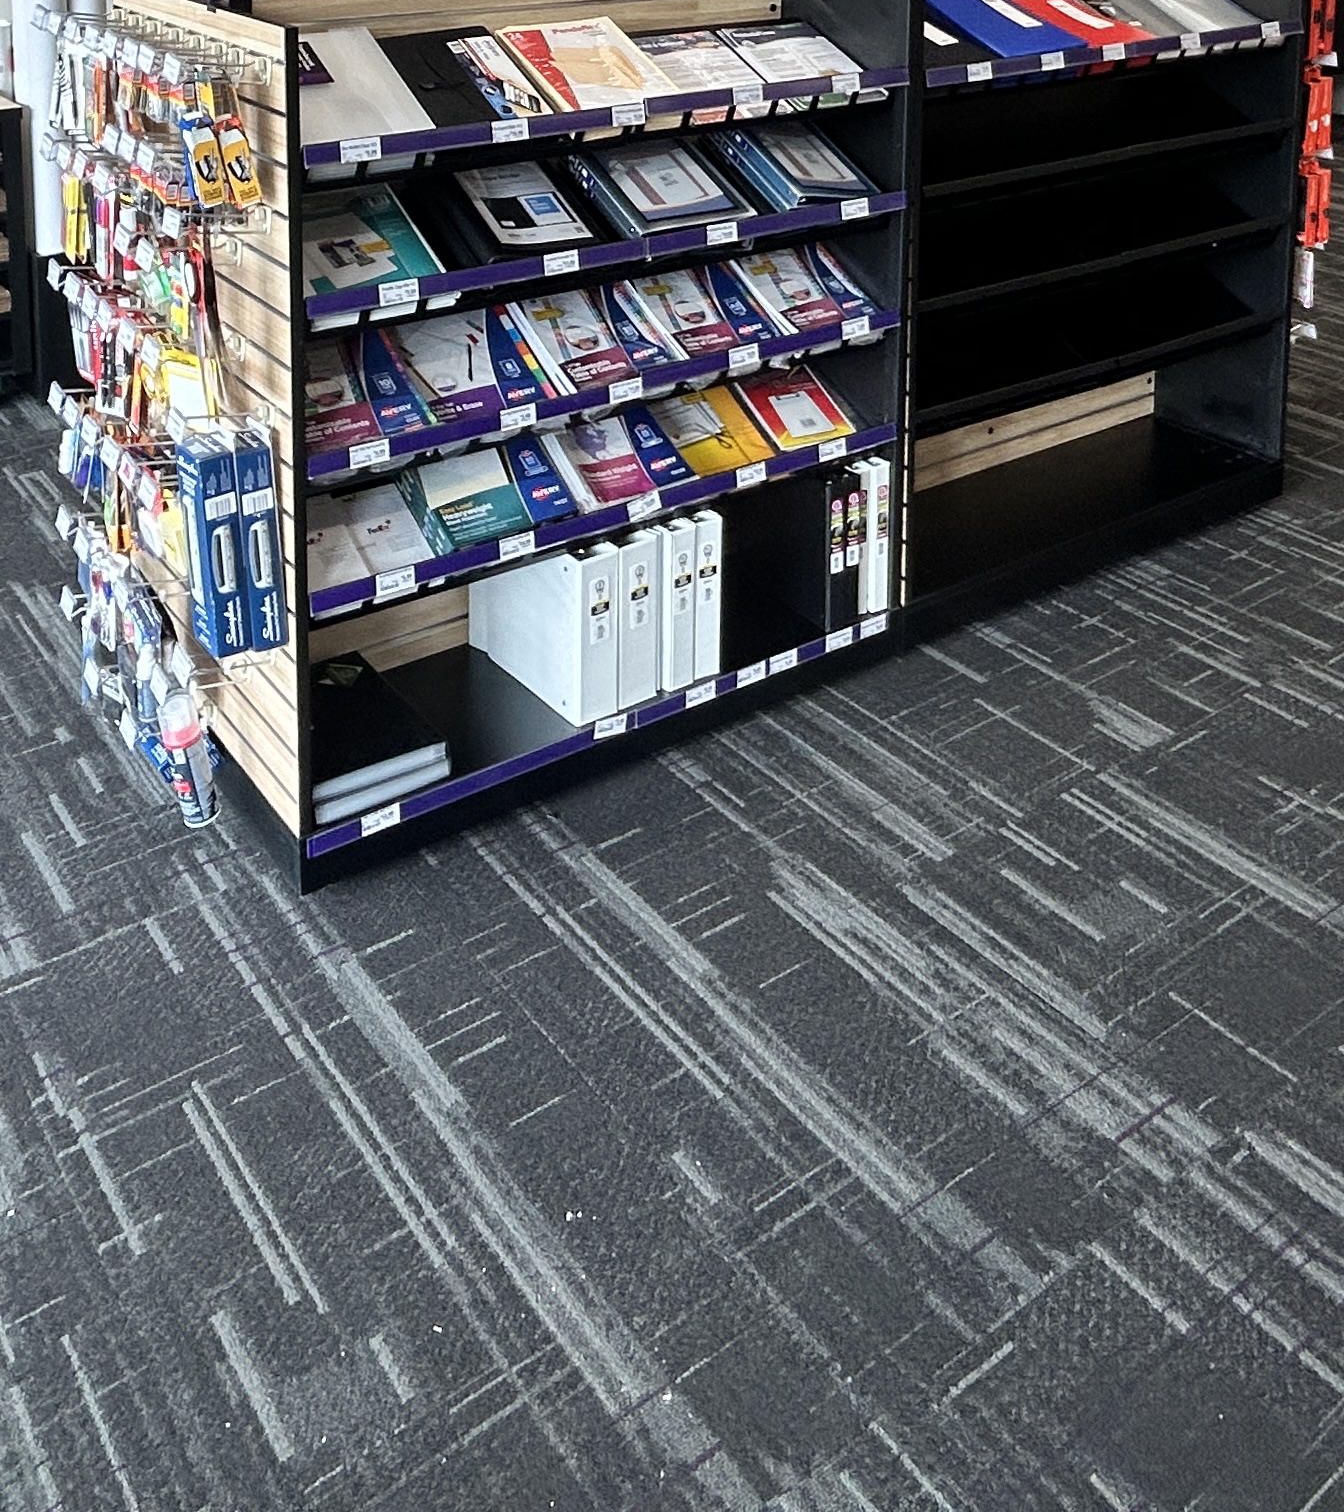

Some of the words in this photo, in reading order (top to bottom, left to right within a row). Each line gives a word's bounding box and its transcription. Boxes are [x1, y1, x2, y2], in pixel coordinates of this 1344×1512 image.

[378, 378, 391, 387] 10
[380, 403, 412, 418] AVERY
[649, 455, 677, 471] AVERY
[531, 484, 560, 499] AVERY
